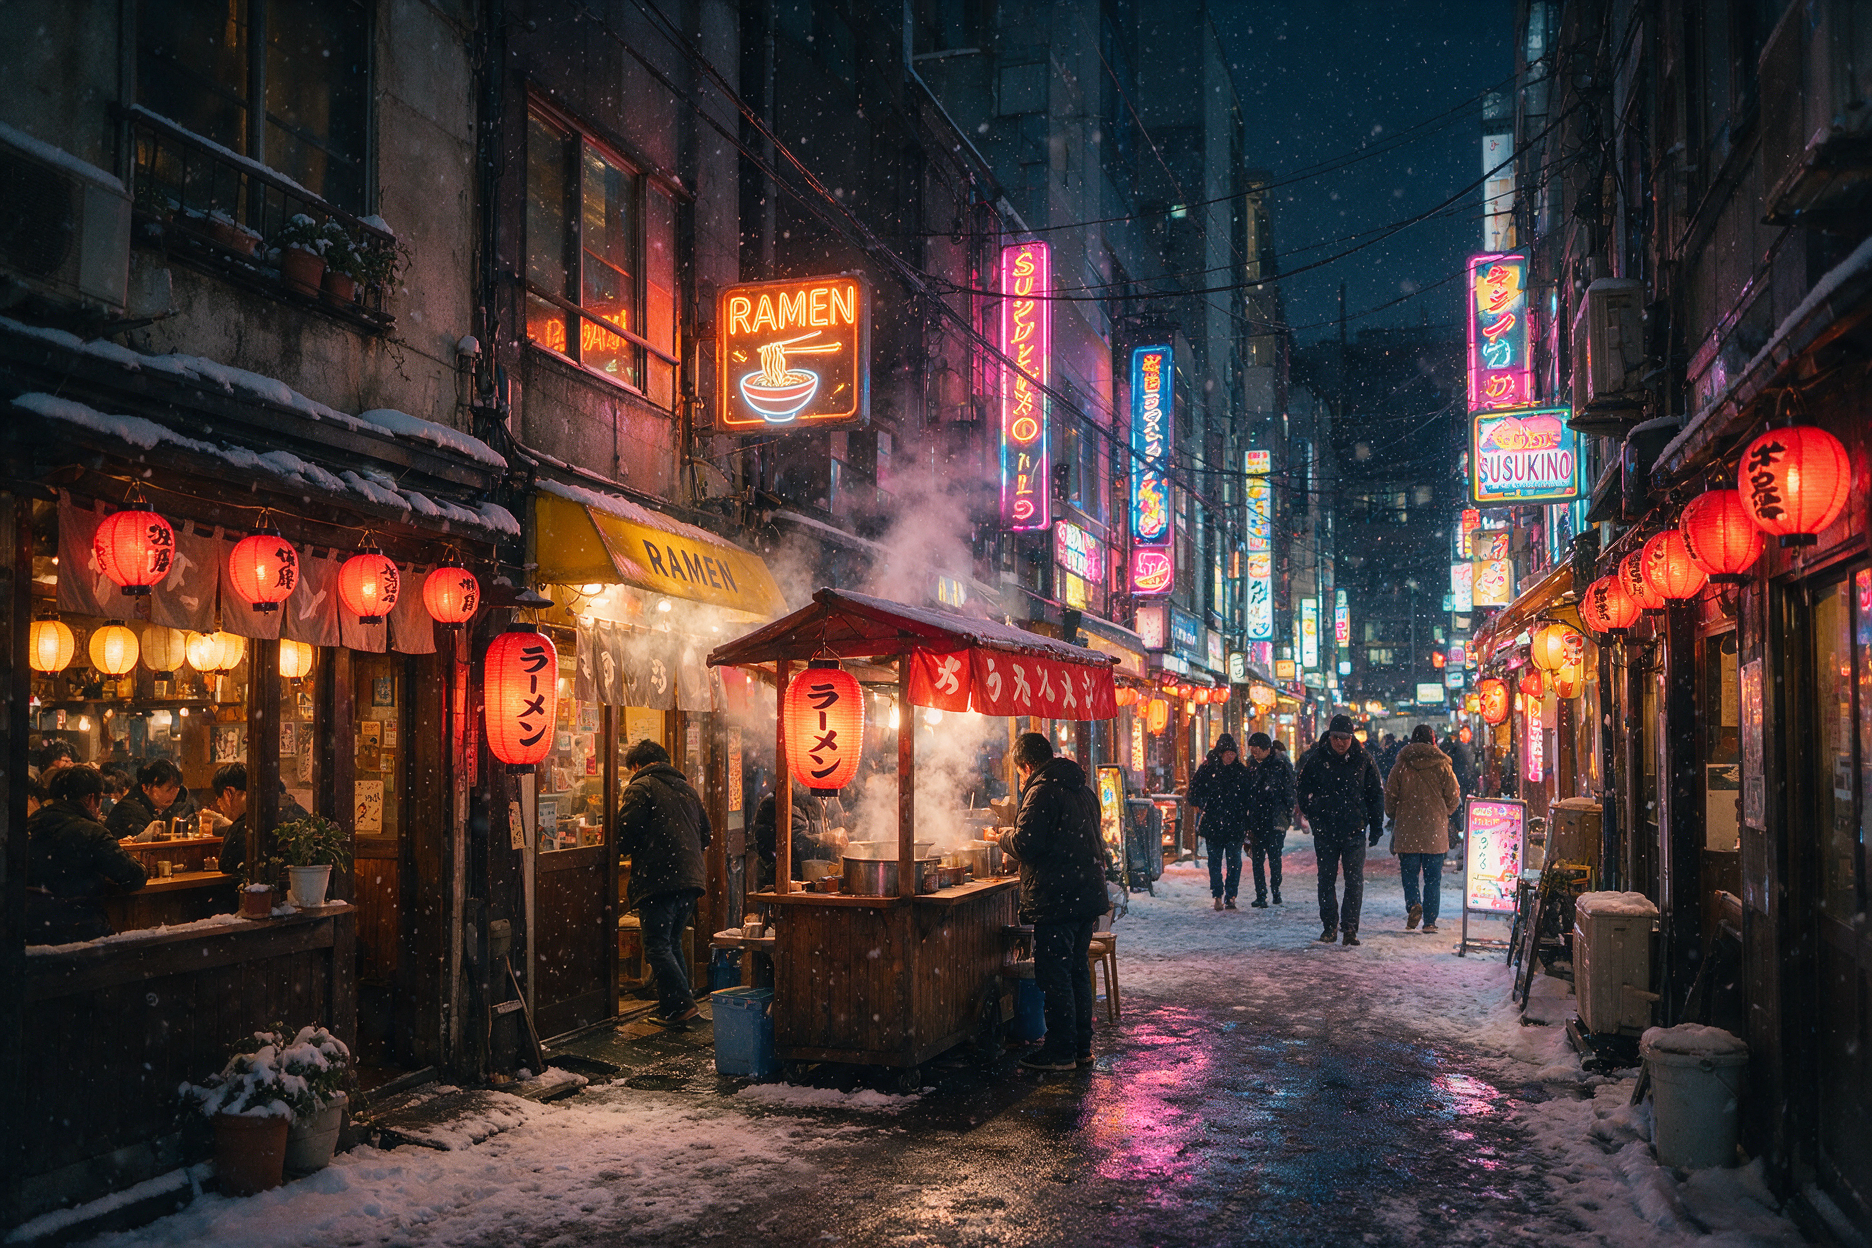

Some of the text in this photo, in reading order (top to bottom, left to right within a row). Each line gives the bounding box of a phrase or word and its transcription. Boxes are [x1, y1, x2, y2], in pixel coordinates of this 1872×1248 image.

[729, 286, 854, 335] RAMEN
[1480, 450, 1572, 483] SUSUKINO
[642, 539, 738, 593] RAMEN
[517, 646, 549, 747] ラーメン
[807, 683, 841, 778] ラーメン
